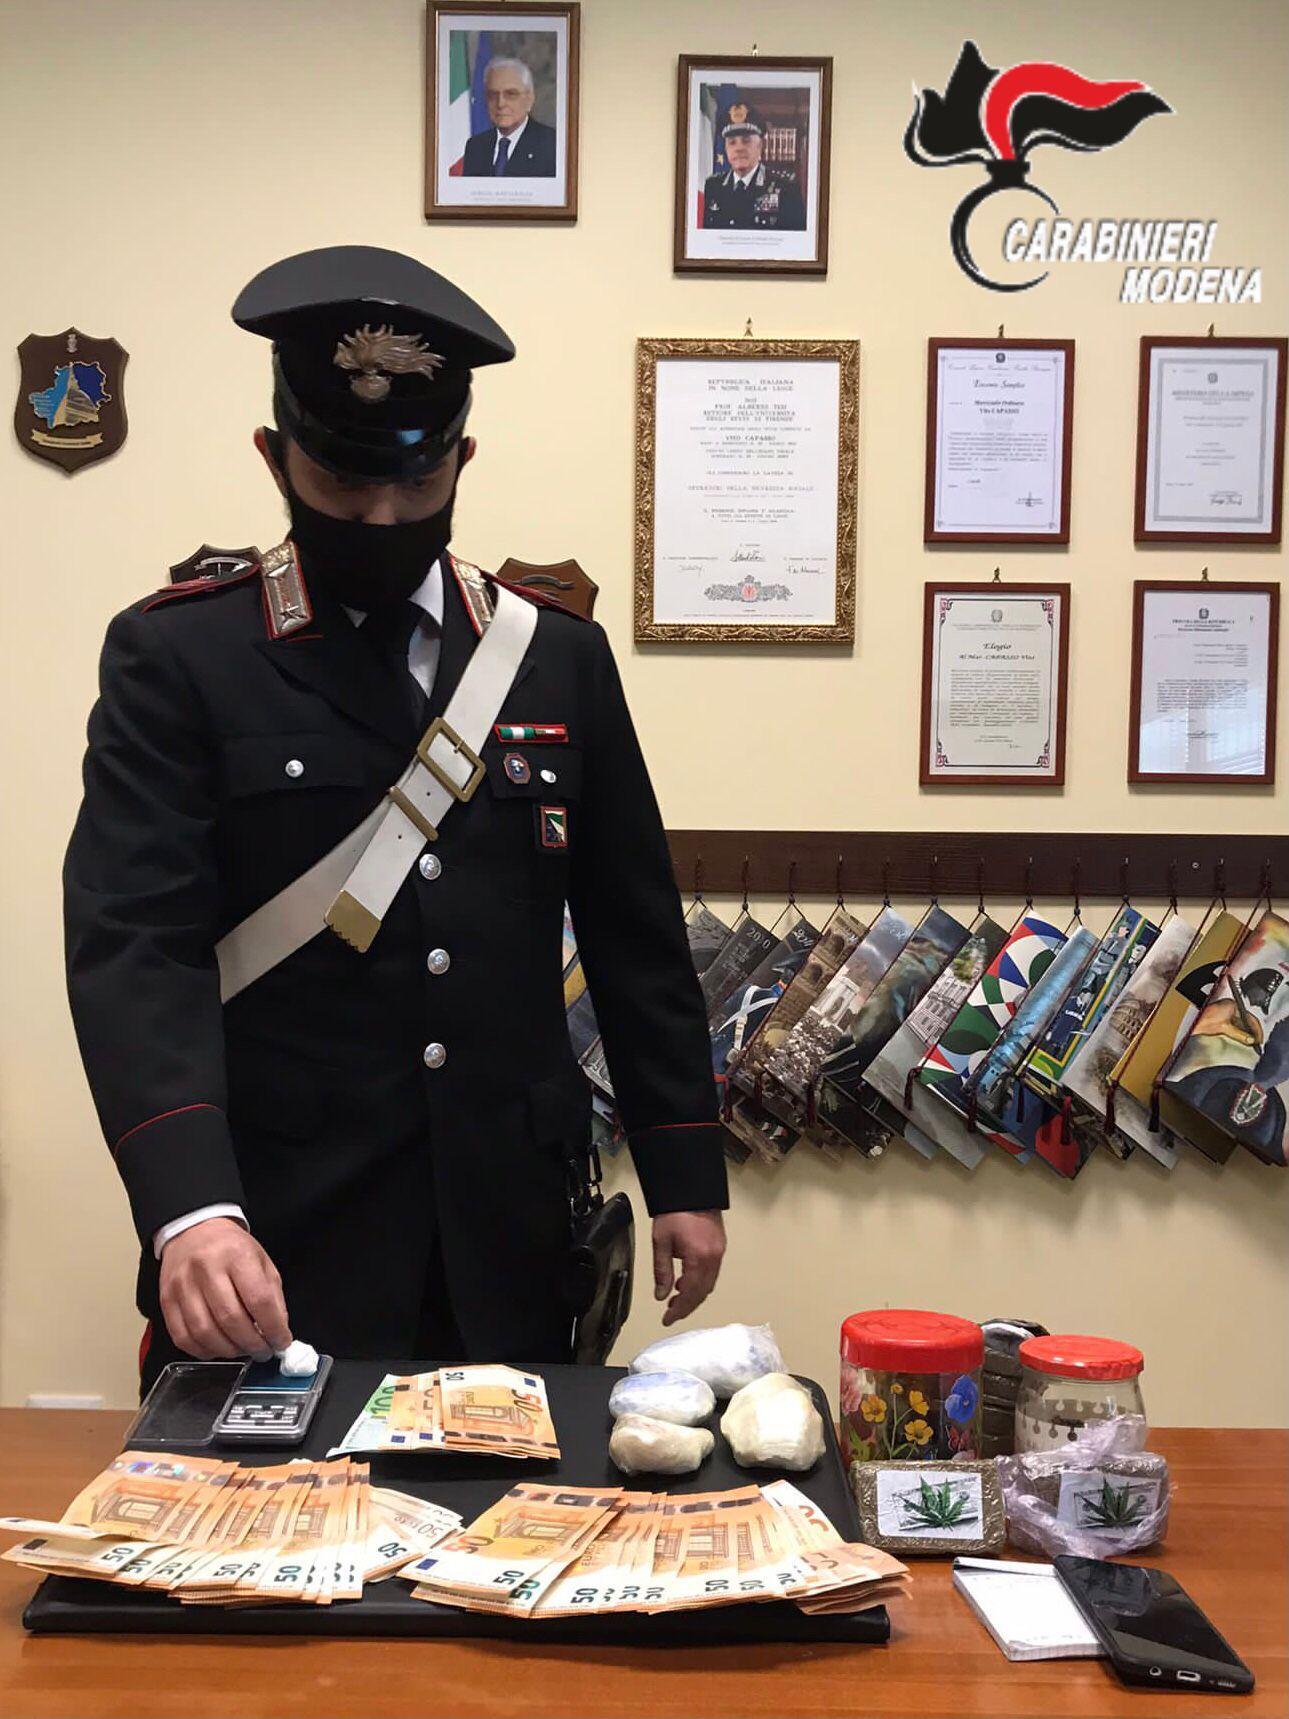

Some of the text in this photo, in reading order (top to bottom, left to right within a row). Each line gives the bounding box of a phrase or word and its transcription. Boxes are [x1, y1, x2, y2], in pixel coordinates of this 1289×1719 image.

[746, 926, 771, 950] 200
[511, 1389, 543, 1412] 50
[377, 1542, 408, 1558] 50
[442, 1535, 494, 1554] 50
[100, 1547, 134, 1563] 50
[118, 1559, 152, 1574] 50
[213, 1563, 243, 1577] 50
[274, 1565, 302, 1583] 50
[492, 1570, 525, 1585] 50
[704, 1579, 729, 1592] 50
[739, 1579, 765, 1591] 50
[508, 1579, 541, 1600] 50
[570, 1587, 599, 1604] 50
